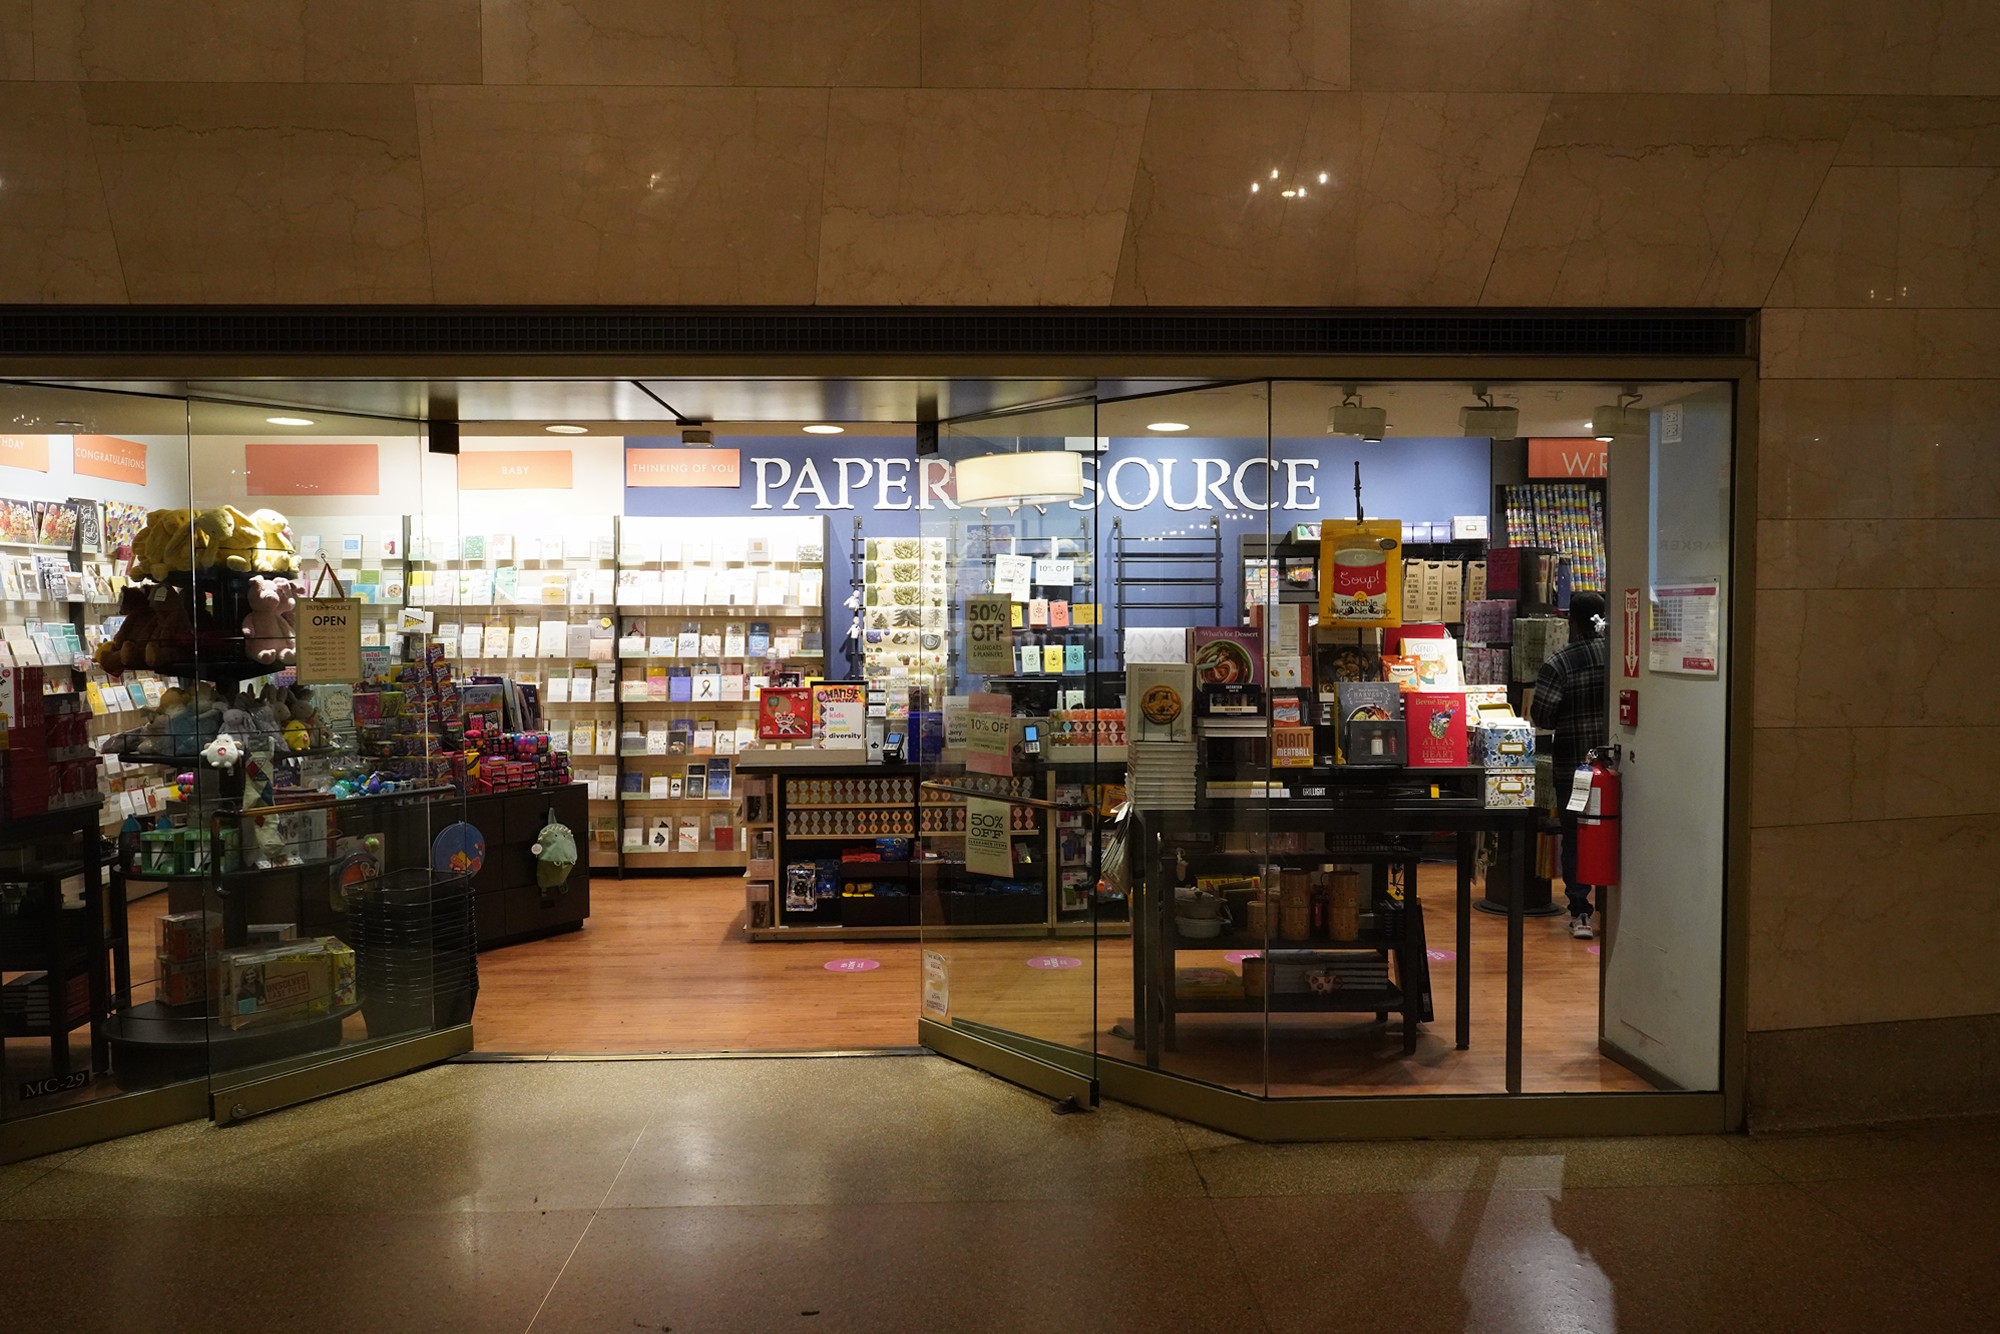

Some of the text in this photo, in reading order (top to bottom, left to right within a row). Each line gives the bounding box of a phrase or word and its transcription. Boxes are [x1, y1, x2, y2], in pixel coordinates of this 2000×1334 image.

[0, 437, 25, 450] HDAY
[75, 447, 145, 470] CONGRATULATIONS
[501, 465, 530, 476] BABY
[632, 462, 735, 475] THINKING OF YOU
[750, 456, 1321, 511] PAPER SOURCE
[1055, 565, 1070, 573] OFF
[1340, 569, 1380, 590] Soup!
[1341, 599, 1378, 607] Heatable
[1627, 597, 1638, 609] FIRE
[969, 603, 1006, 622] 50%
[1328, 606, 1368, 617] Hugble
[312, 616, 346, 626] OPEN
[971, 623, 1004, 642] OFF
[817, 688, 861, 703] CHANGE
[1437, 698, 1459, 706] Brown
[970, 719, 1009, 734] 10% OFF
[1276, 733, 1311, 747] GIANT
[1422, 738, 1455, 746] ATLAS
[1276, 747, 1310, 757] MEATBALL
[971, 813, 1003, 828] 50%
[971, 827, 1004, 839] OFF
[266, 975, 307, 993] UNSOLVED
[24, 1073, 86, 1098] MC-29
